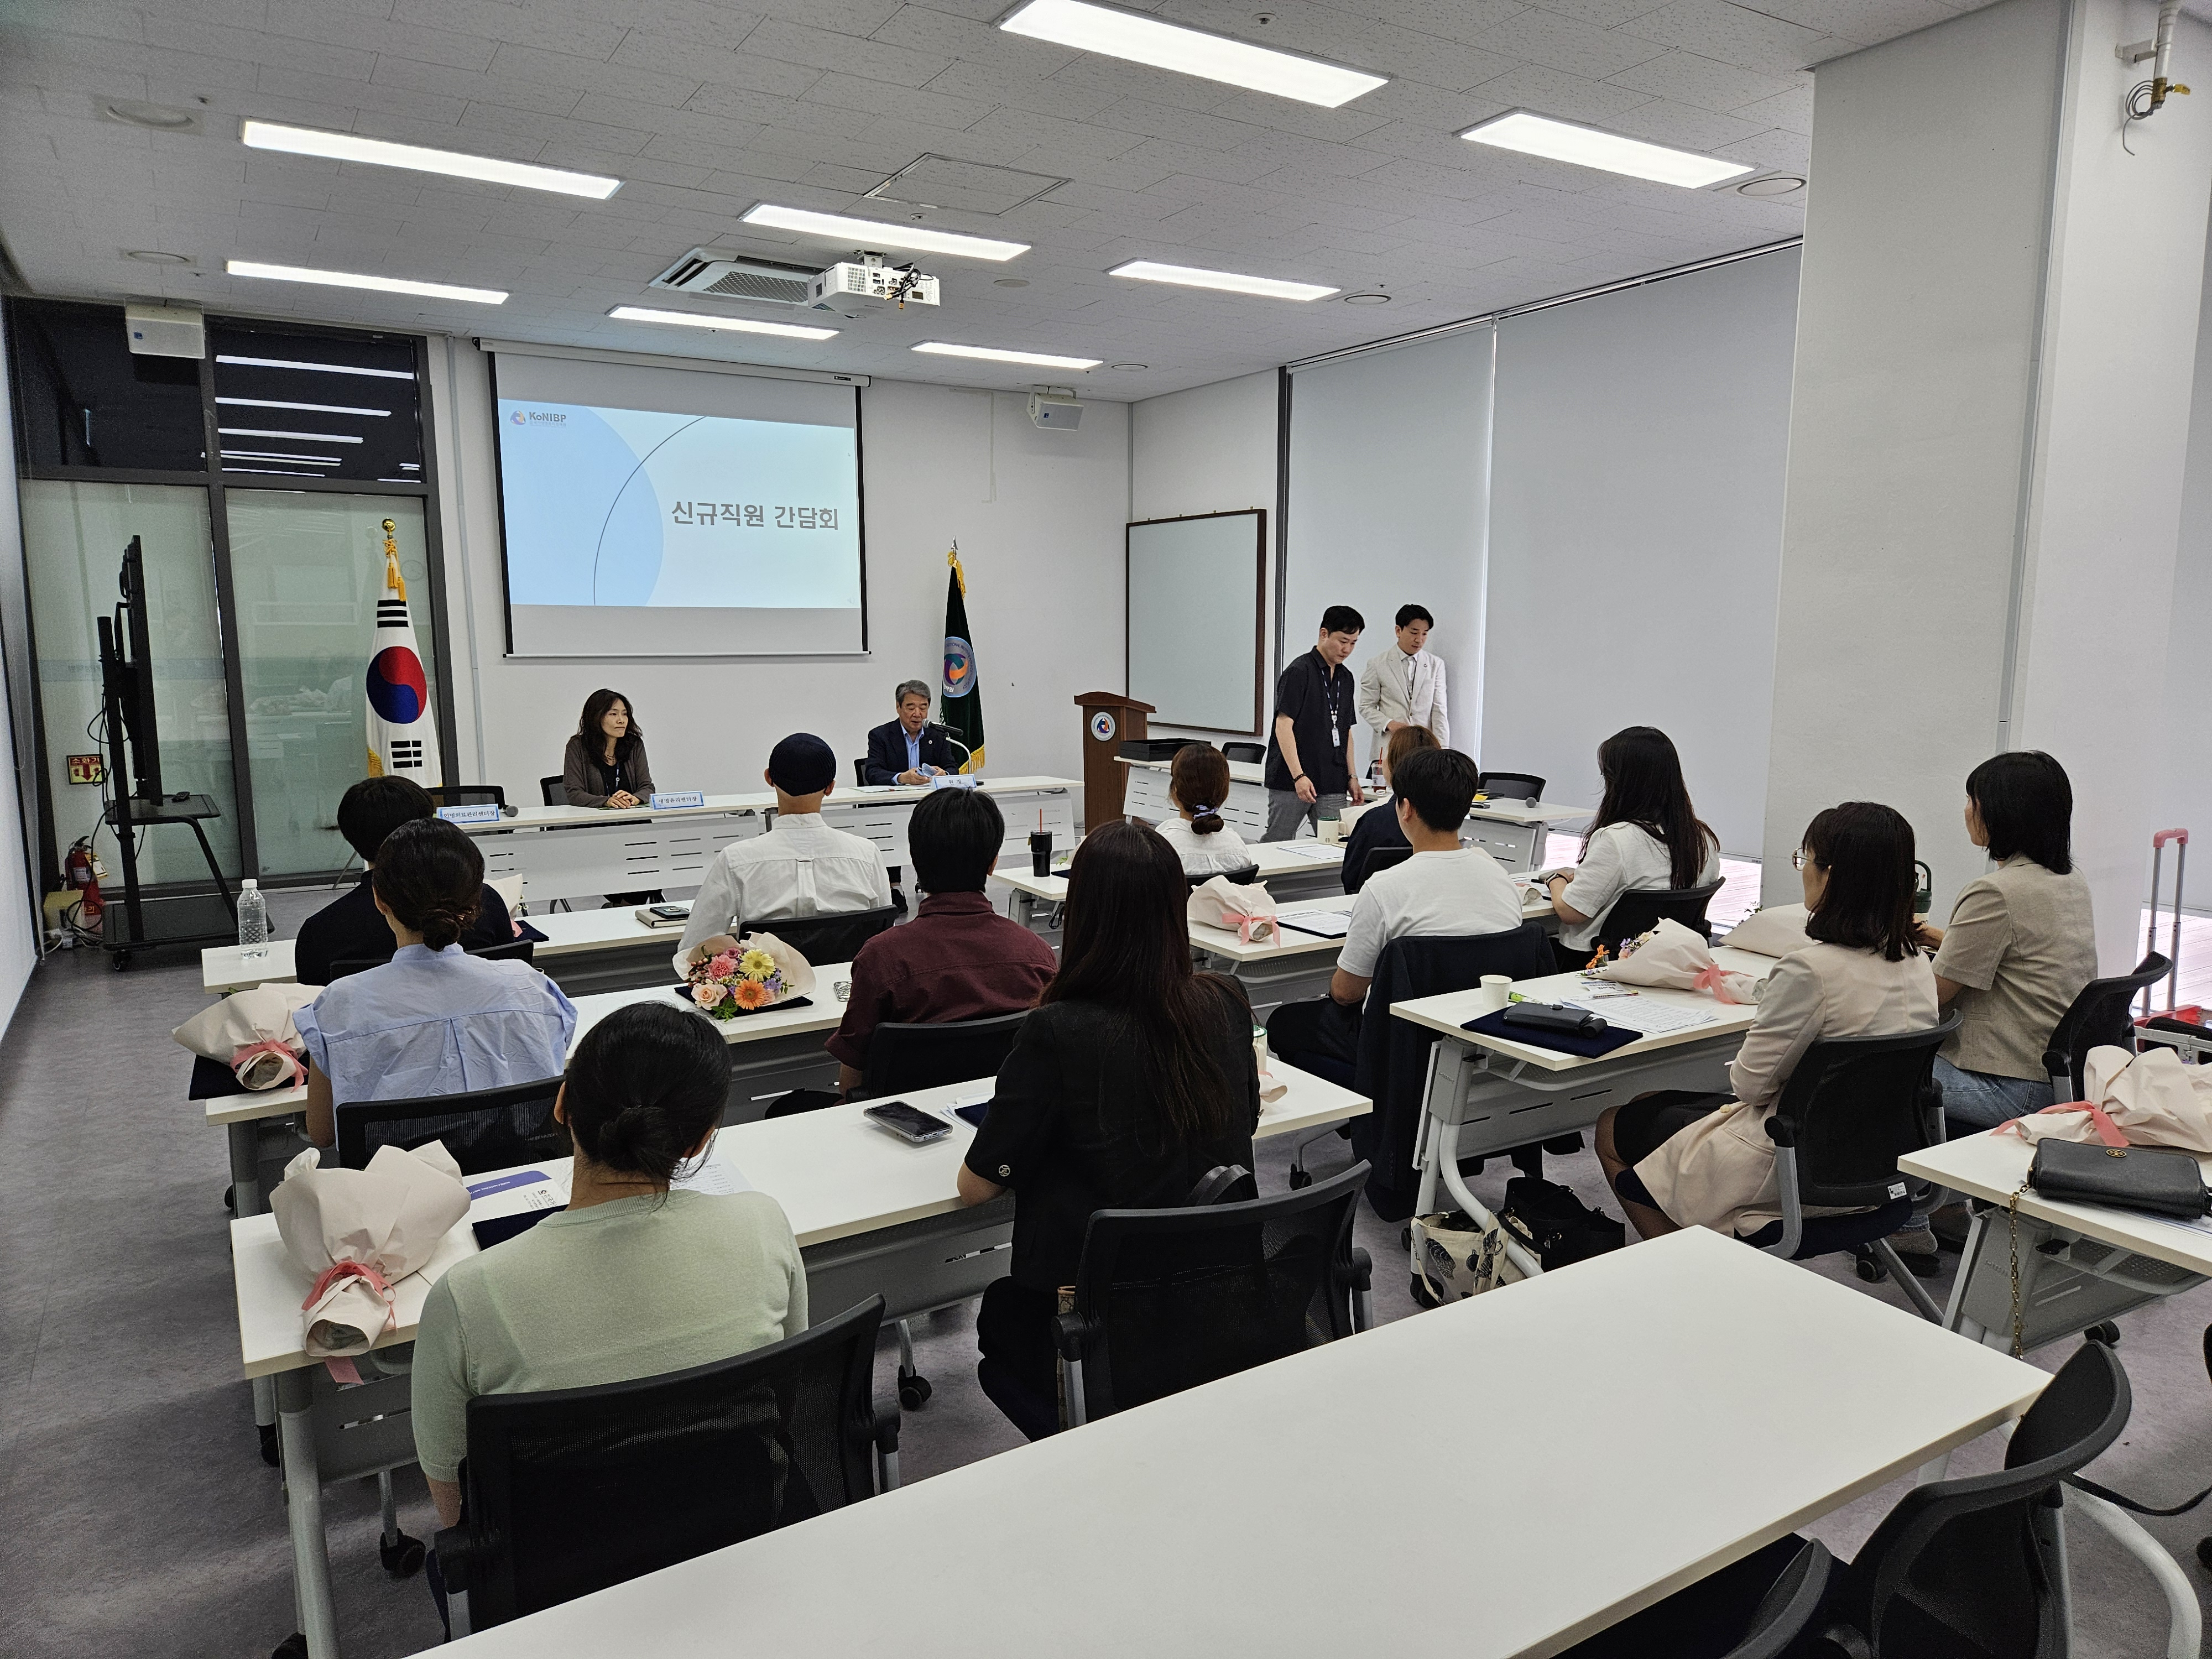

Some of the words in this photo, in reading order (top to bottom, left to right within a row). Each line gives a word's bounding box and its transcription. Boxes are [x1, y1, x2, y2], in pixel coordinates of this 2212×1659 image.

[529, 411, 566, 422] KoNIBP
[671, 500, 765, 527] 신규직원
[774, 504, 839, 530] 간담회
[658, 796, 698, 804] 생명윤리센터장
